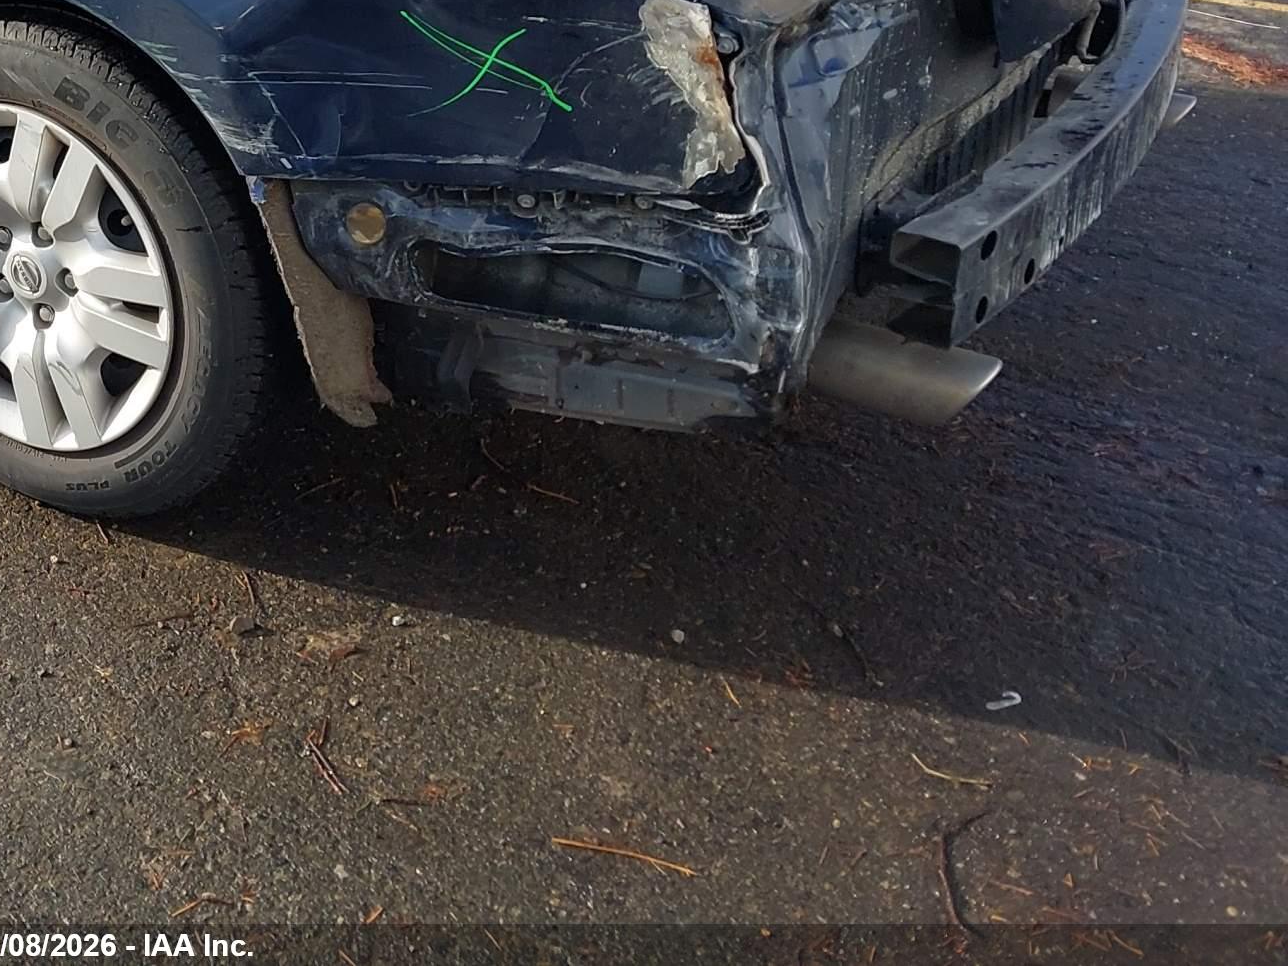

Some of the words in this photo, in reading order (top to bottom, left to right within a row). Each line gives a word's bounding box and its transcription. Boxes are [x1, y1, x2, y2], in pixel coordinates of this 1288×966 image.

[53, 77, 139, 149] BIG
[123, 440, 177, 483] TOUR
[66, 480, 110, 491] PLUS
